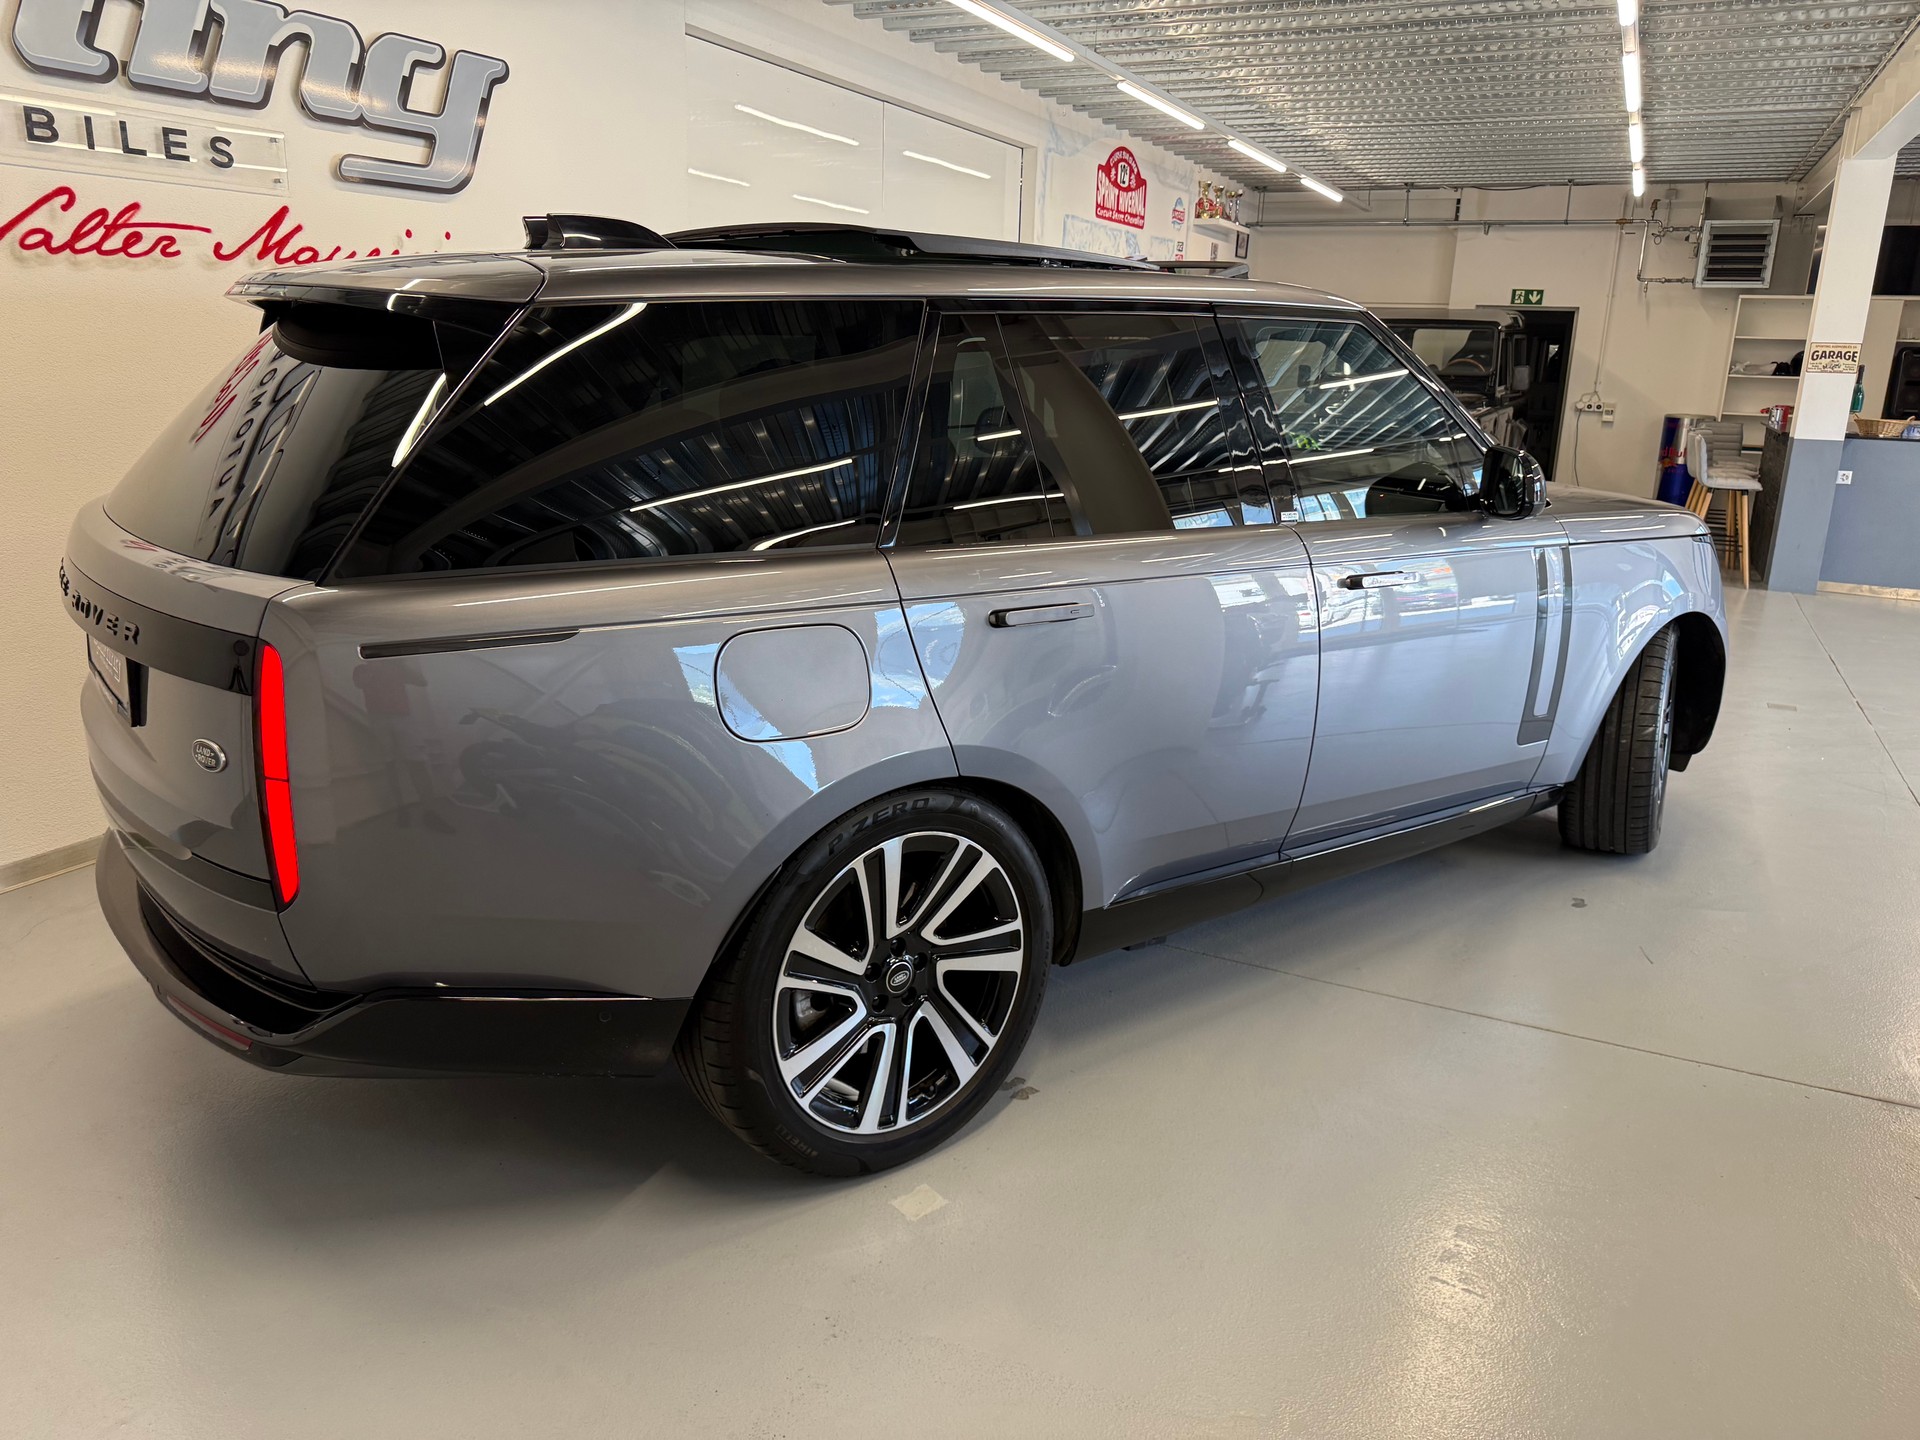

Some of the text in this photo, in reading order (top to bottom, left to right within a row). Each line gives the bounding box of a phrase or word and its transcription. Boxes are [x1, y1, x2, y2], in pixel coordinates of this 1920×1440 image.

[22, 104, 235, 169] BILES
[1098, 170, 1119, 211] SPRINT
[0, 185, 213, 259] alter
[1811, 350, 1858, 362] GARAGE
[851, 797, 930, 837] ZERO
